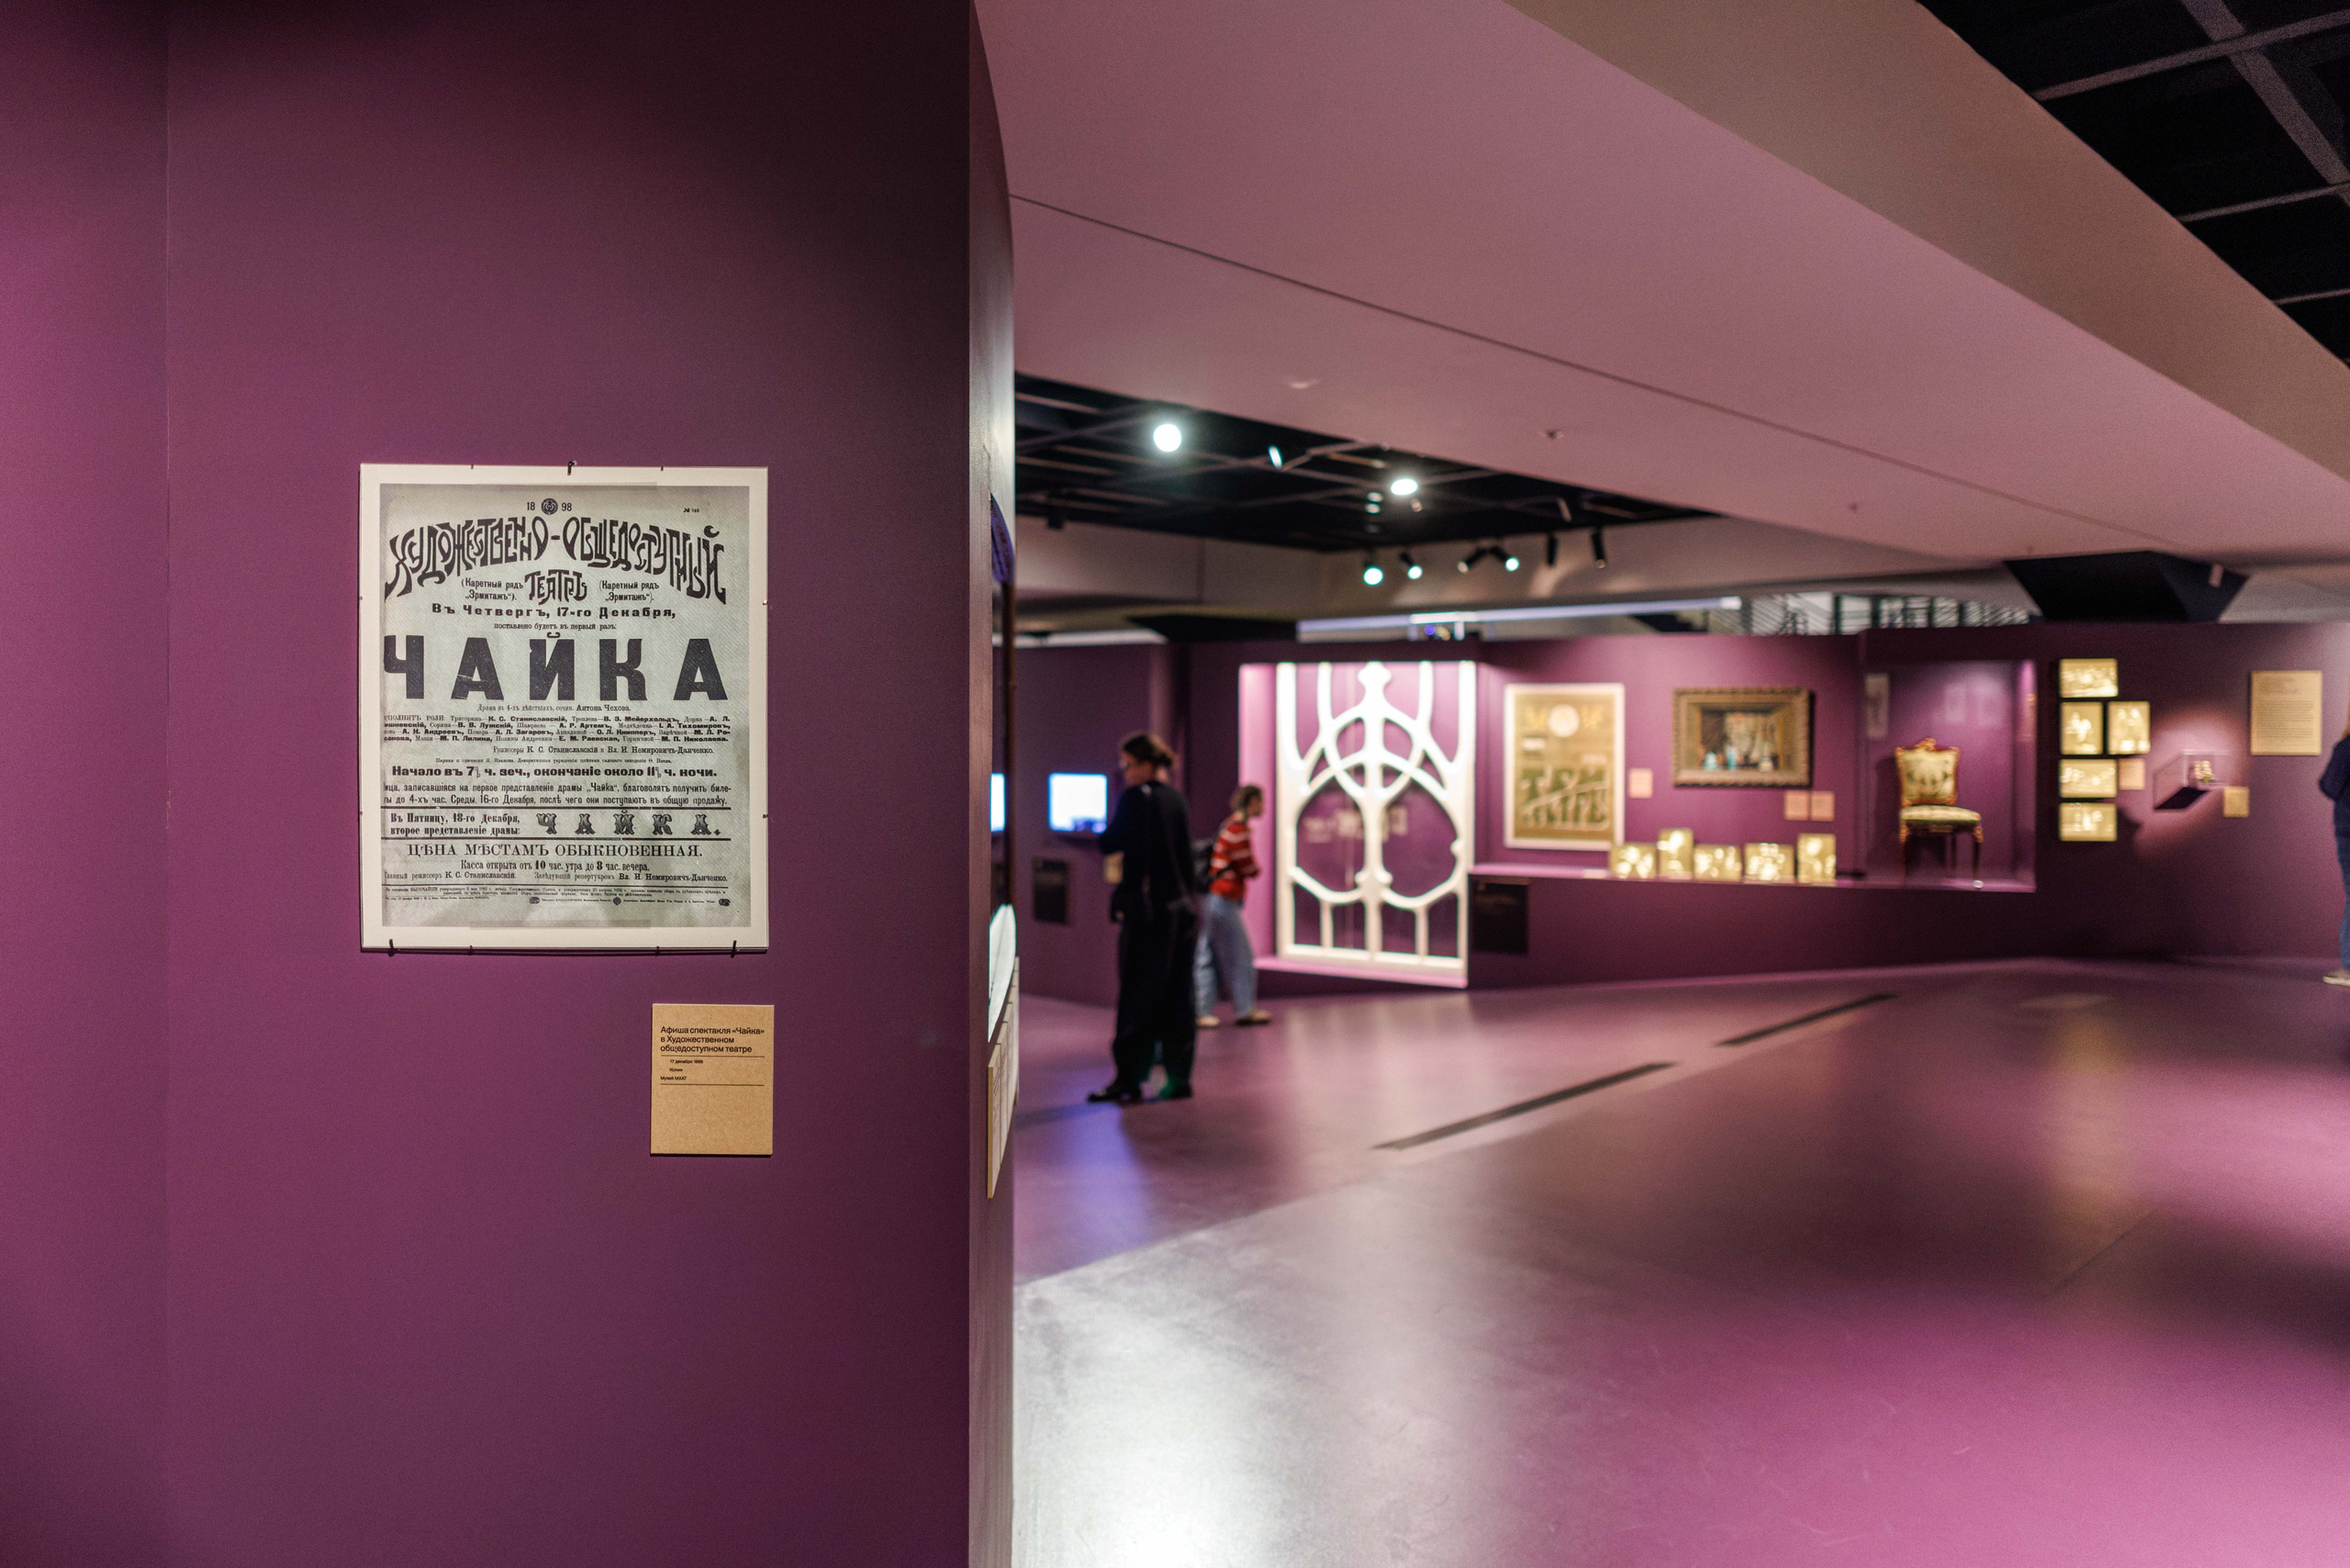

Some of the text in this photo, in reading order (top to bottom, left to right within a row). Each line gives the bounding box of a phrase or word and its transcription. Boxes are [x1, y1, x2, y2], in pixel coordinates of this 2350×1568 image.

[527, 502, 572, 512] 18 98
[461, 577, 524, 591] (Каретный рядъ
[599, 580, 659, 592] (Каретный рядъ
[432, 603, 676, 619] Въ Четвергъ, 17-го Декабря,
[383, 631, 728, 701] ЧАЙКА
[477, 704, 496, 712] Драма
[392, 765, 441, 777] Начало
[500, 768, 530, 778] веч.,
[534, 766, 601, 777] окончаніе
[604, 768, 644, 776] около
[664, 768, 676, 777] ч.
[680, 768, 717, 777] ночи.
[403, 782, 456, 792] записавшіяся
[472, 785, 498, 793] первое
[501, 783, 554, 793] представленіе
[558, 785, 582, 793] драмы
[623, 783, 670, 792] благоволятъ
[672, 785, 707, 794] получить
[710, 783, 732, 792] биле-
[395, 796, 405, 804] до
[409, 794, 428, 804] 4-хъ
[480, 794, 499, 804] 16-го
[539, 795, 562, 804] послѣ
[603, 797, 647, 806] поступаютъ
[663, 795, 688, 807] общую
[693, 796, 727, 807] продажу.
[390, 813, 520, 825] Въ Пятницу, 18-го Декабря,
[390, 826, 520, 837] второе представленіе драмы:
[408, 843, 703, 858] ЦѢНА МѢСТАМЪ ОБЫКНОВЕННАЯ.
[460, 860, 483, 870] Касса
[486, 861, 517, 872] открыта
[535, 860, 546, 870] 10
[565, 862, 583, 873] утра
[585, 863, 594, 871] до
[596, 861, 603, 871] 8
[605, 863, 621, 871] час.
[622, 864, 650, 873] вечера.
[645, 874, 728, 882] Немировичъ-Данченко.
[661, 1026, 689, 1035] Афиша
[667, 1036, 735, 1044] Художественном
[660, 1045, 724, 1053] общедоступном
